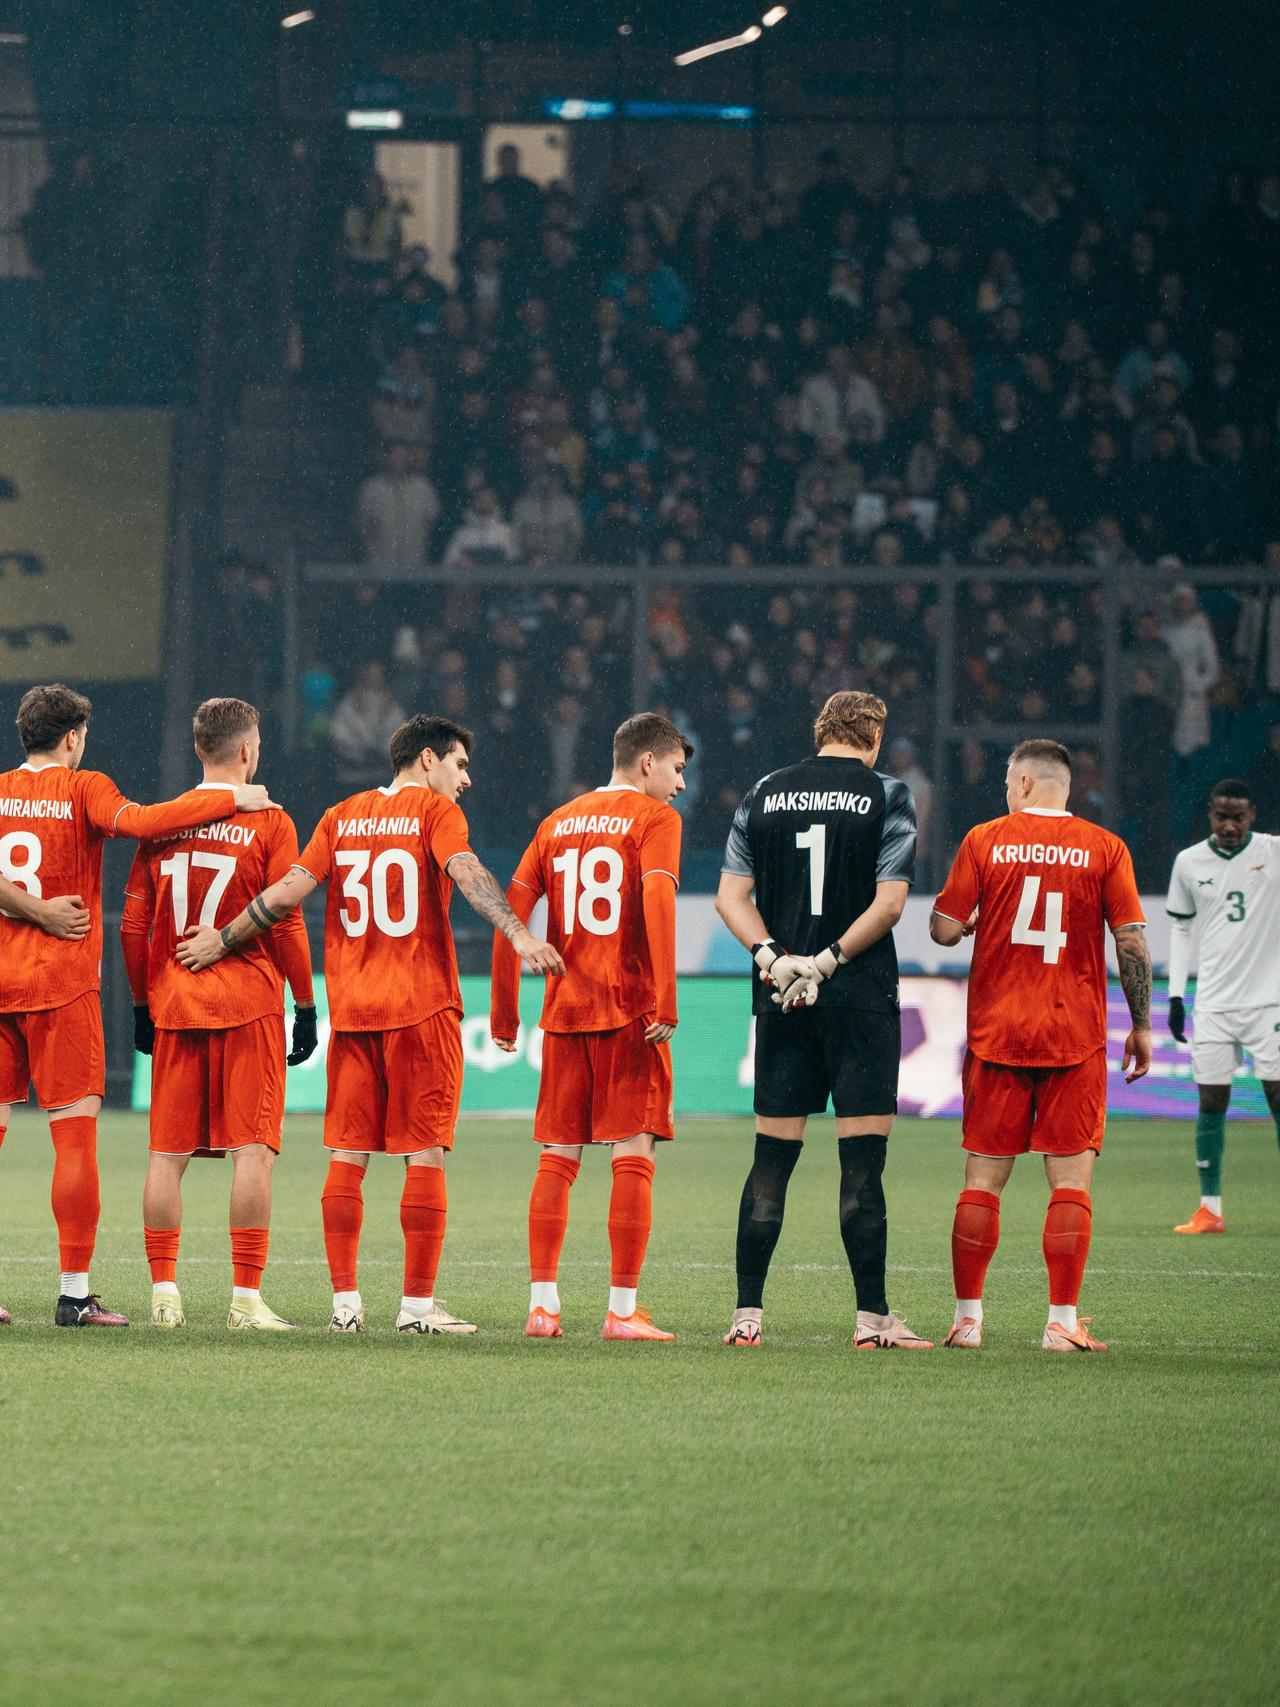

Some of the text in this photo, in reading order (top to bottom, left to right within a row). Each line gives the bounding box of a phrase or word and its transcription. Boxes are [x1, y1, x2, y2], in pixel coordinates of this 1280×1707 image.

[337, 816, 421, 838] VAKHANIIA
[553, 815, 635, 838] KOMAROV
[763, 791, 872, 815] MAKSIMENKO
[795, 824, 826, 916] 1
[992, 843, 1090, 868] KRUGOVOI
[160, 850, 238, 937] 17
[334, 848, 419, 938] 30
[552, 846, 624, 936] 18
[1010, 875, 1068, 965] 4
[1226, 890, 1246, 923] 3
